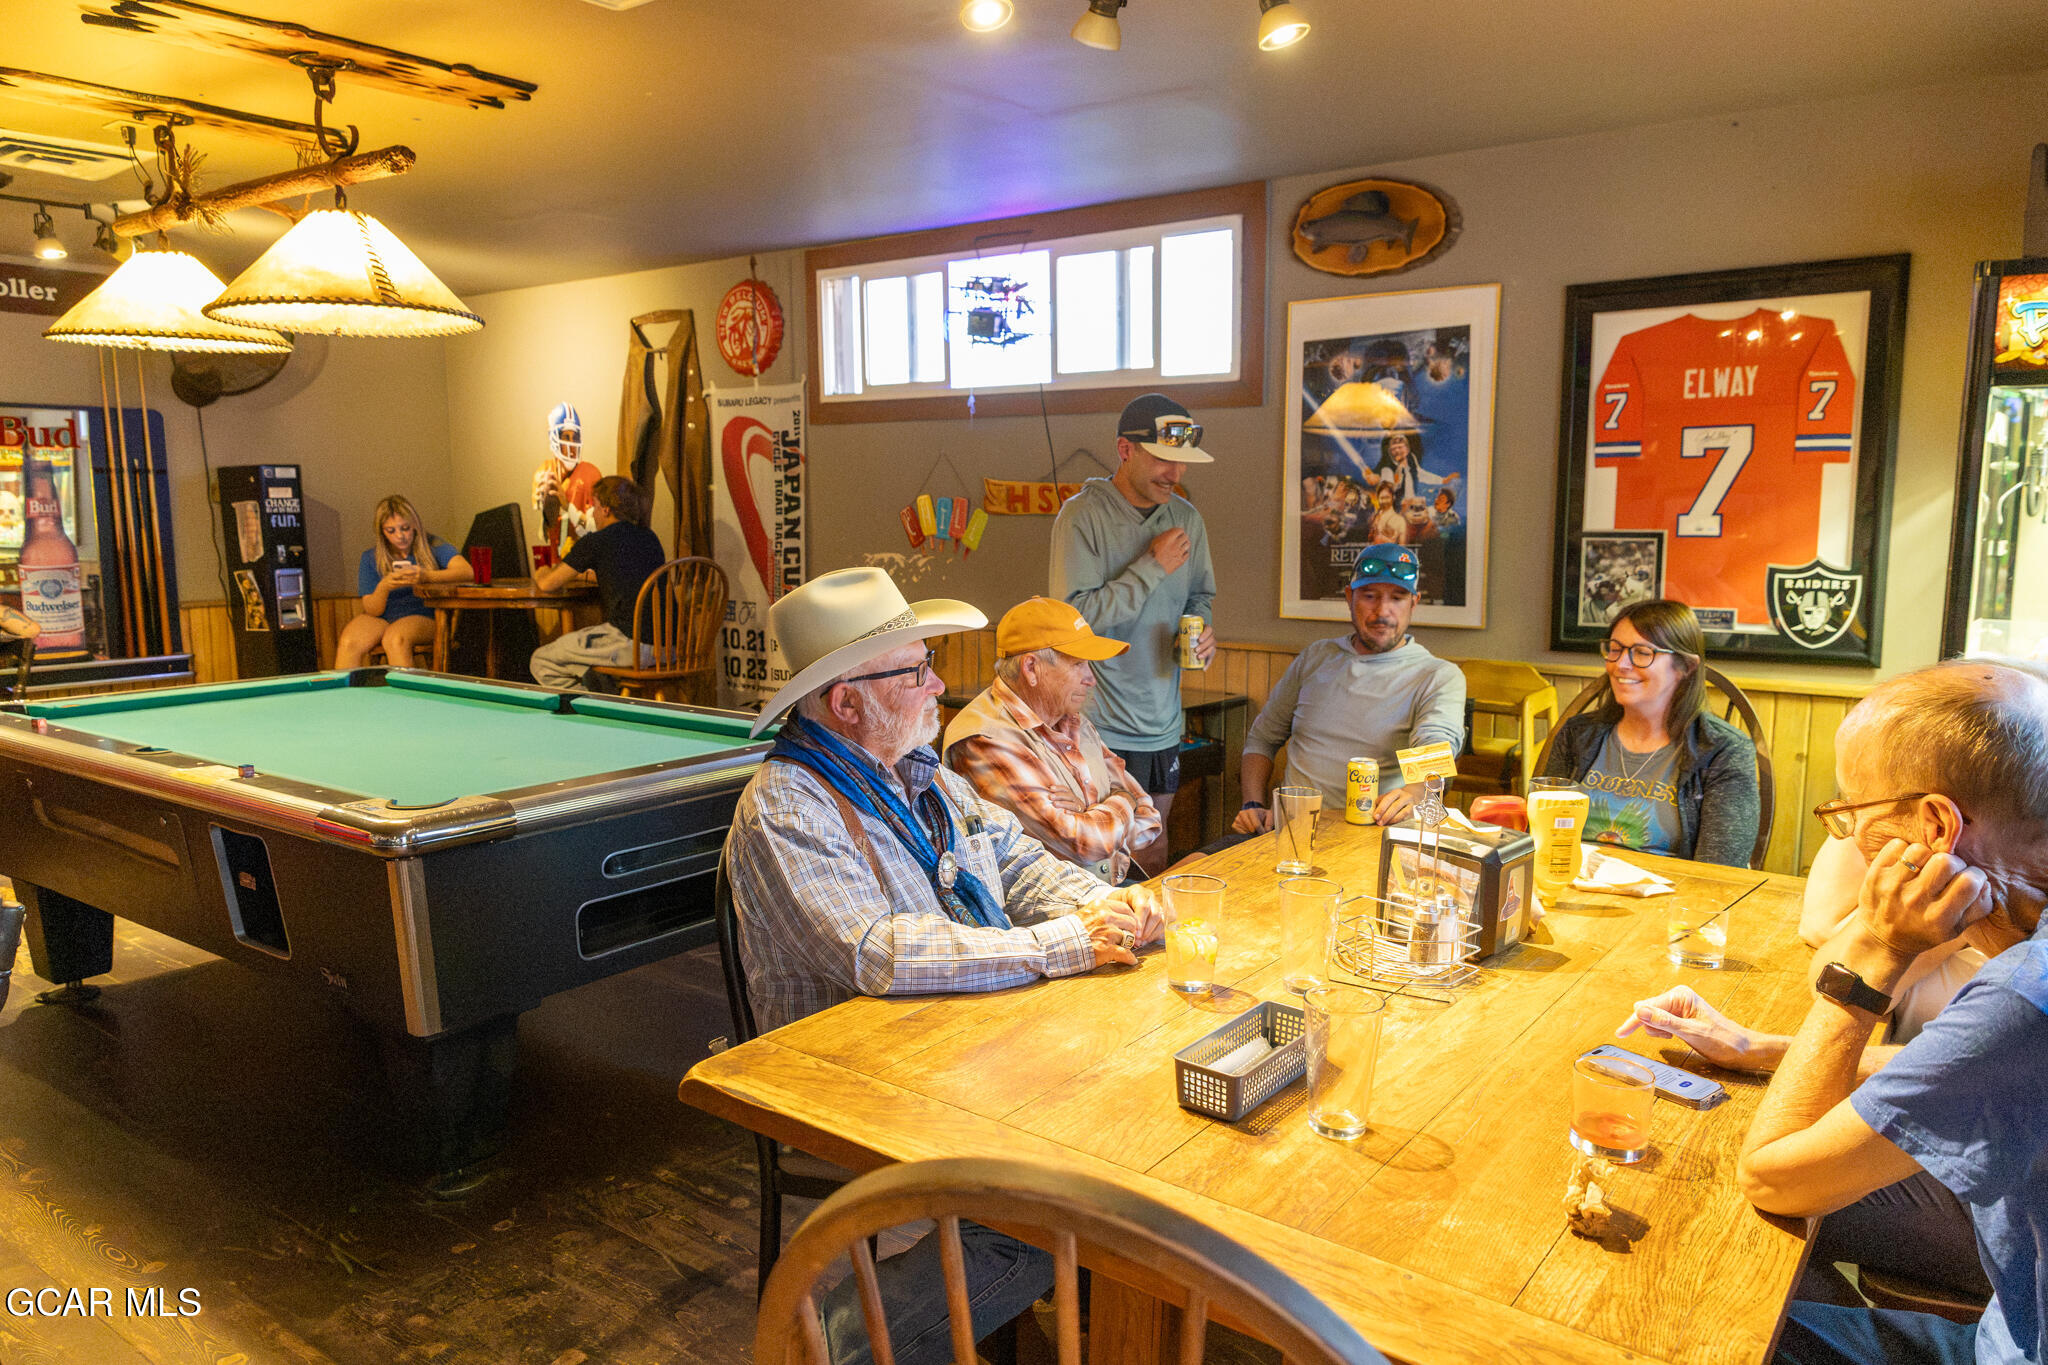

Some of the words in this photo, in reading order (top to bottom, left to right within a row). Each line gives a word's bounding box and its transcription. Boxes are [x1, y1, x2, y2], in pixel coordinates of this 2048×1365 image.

[729, 290, 768, 321] BELGUM
[1683, 365, 1759, 400] ELWAY
[1807, 379, 1838, 421] 7
[745, 396, 771, 407] LEGACY
[1604, 391, 1628, 430] 7
[0, 416, 81, 449] Bud
[772, 431, 783, 473] CYCLE
[774, 480, 784, 515] ROAD
[781, 430, 801, 540] JAPAN
[1676, 423, 1755, 538] 7
[29, 500, 59, 514] Bud
[775, 522, 783, 557] RACE
[783, 546, 801, 597] CU
[1784, 579, 1851, 590] RAIDERS
[26, 601, 81, 614] Budweiser
[722, 627, 766, 653] 10.21
[724, 655, 767, 681] 10.23
[1582, 769, 1678, 807] OURNEY
